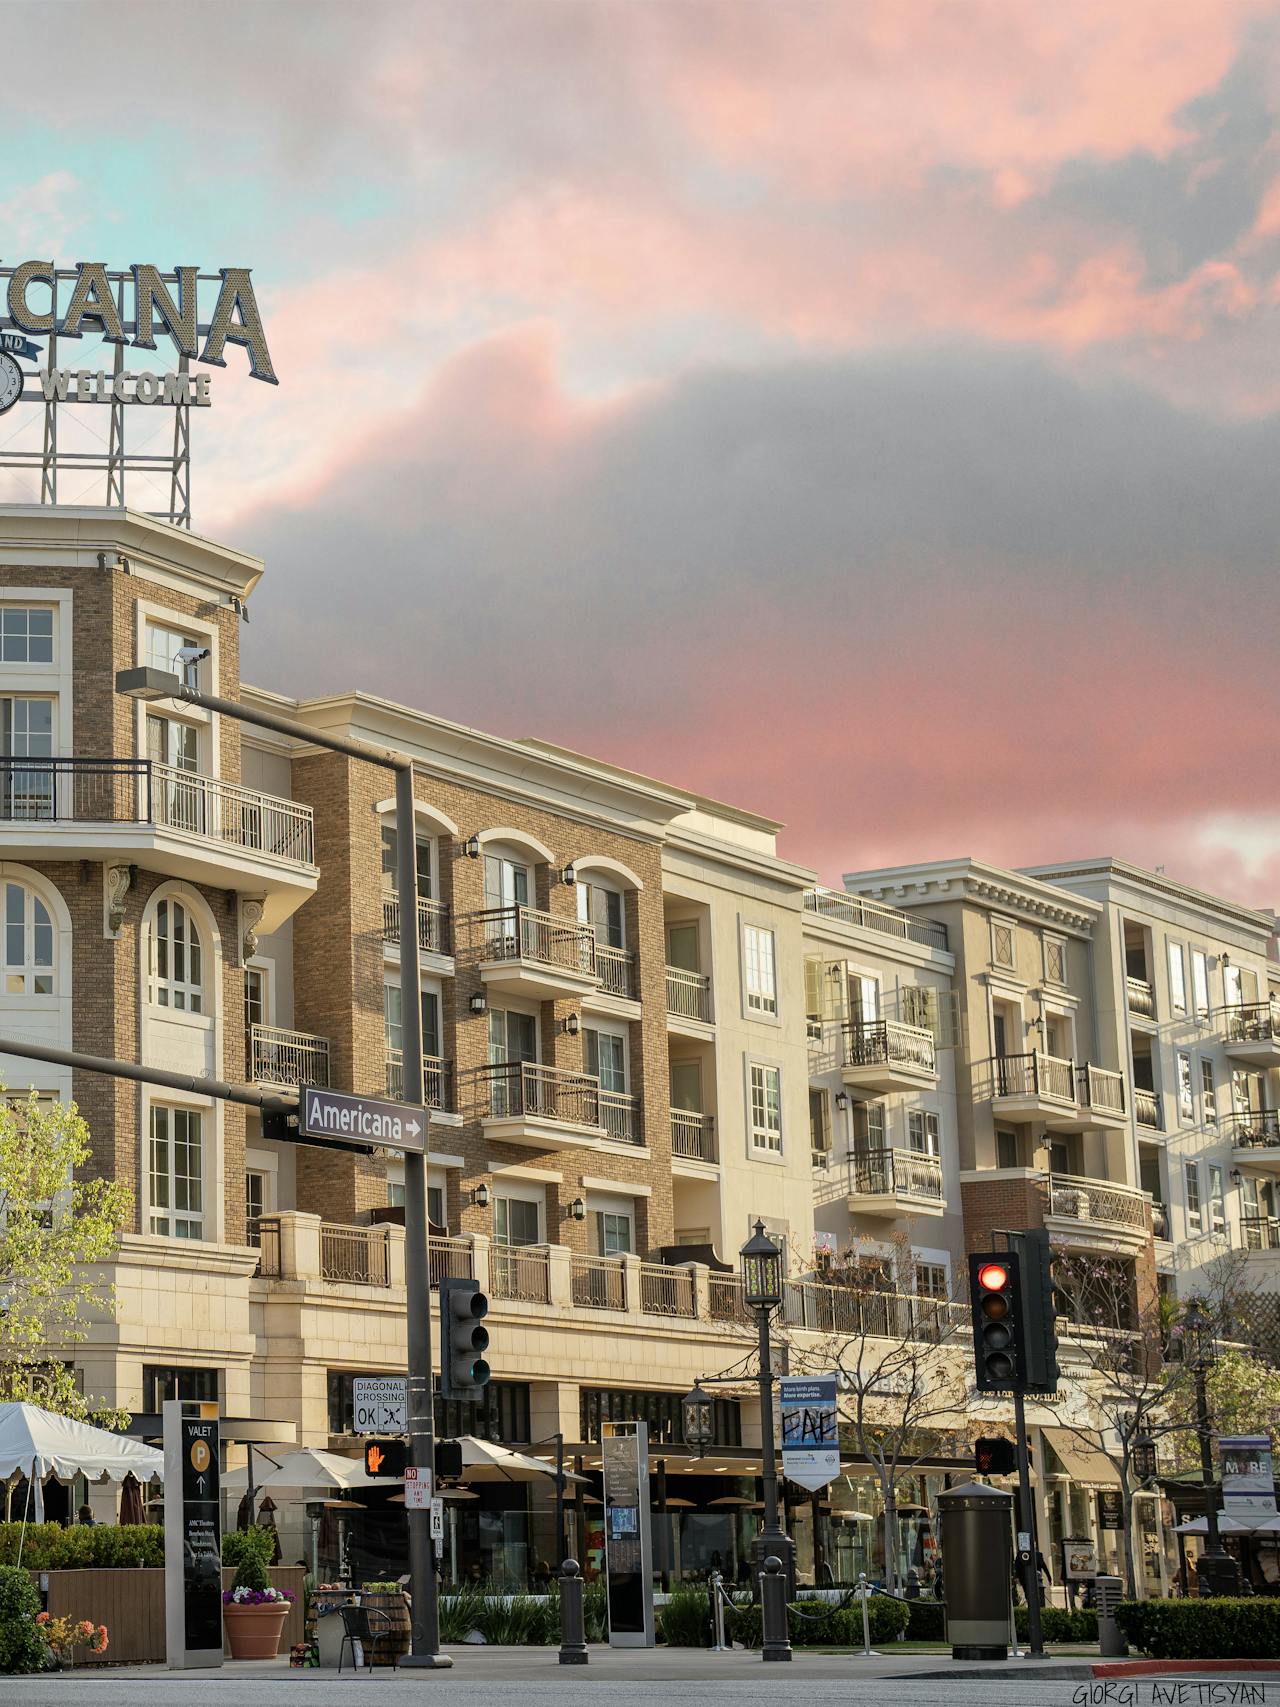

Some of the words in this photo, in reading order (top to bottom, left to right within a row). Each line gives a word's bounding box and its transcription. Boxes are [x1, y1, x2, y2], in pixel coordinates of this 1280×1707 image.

[39, 367, 211, 406] WELCOME
[309, 1096, 402, 1139] Americana
[357, 1382, 404, 1391] DIAGONAL
[356, 1393, 405, 1401] CROSSING
[358, 1407, 376, 1425] OK
[188, 1426, 212, 1437] VALET
[196, 1446, 205, 1464] P
[407, 1469, 416, 1479] NO
